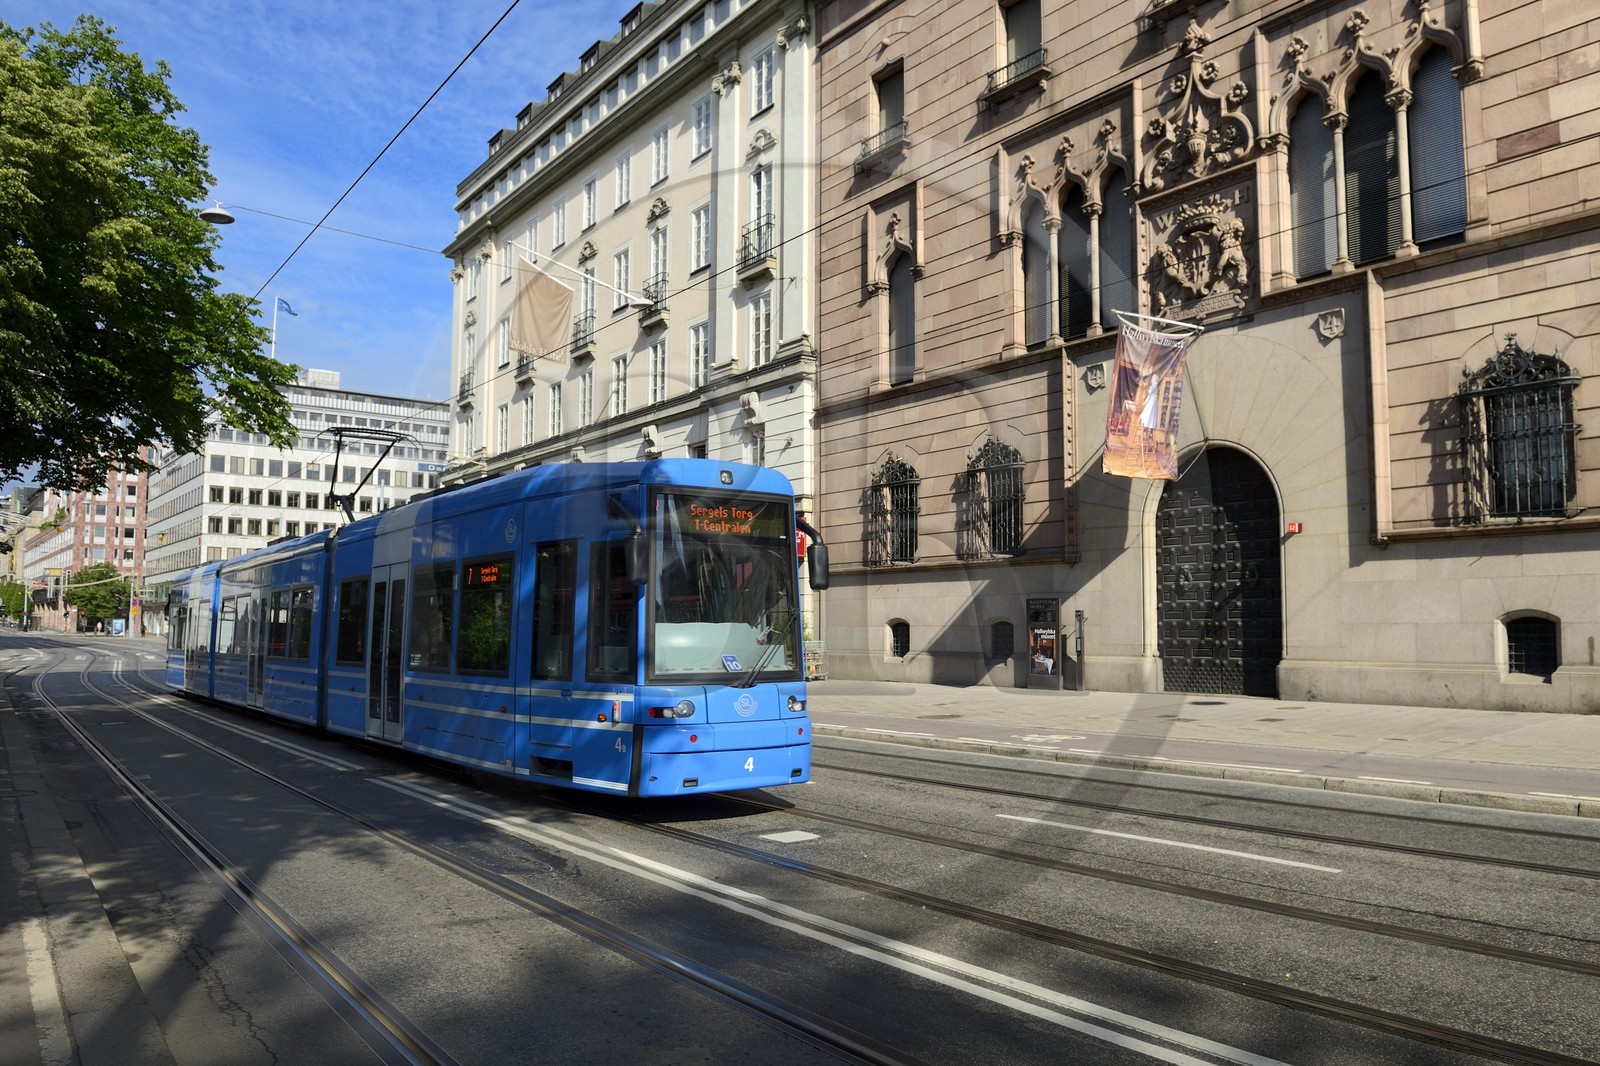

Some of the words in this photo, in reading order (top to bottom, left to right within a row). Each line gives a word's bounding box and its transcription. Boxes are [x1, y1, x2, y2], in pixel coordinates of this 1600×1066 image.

[511, 340, 537, 355] Nobis
[690, 503, 728, 518] Sergels
[731, 506, 753, 521] Torg
[694, 518, 751, 534] T-Centralen
[727, 661, 742, 670] 10
[741, 698, 751, 707] SL
[744, 757, 754, 772] 4
